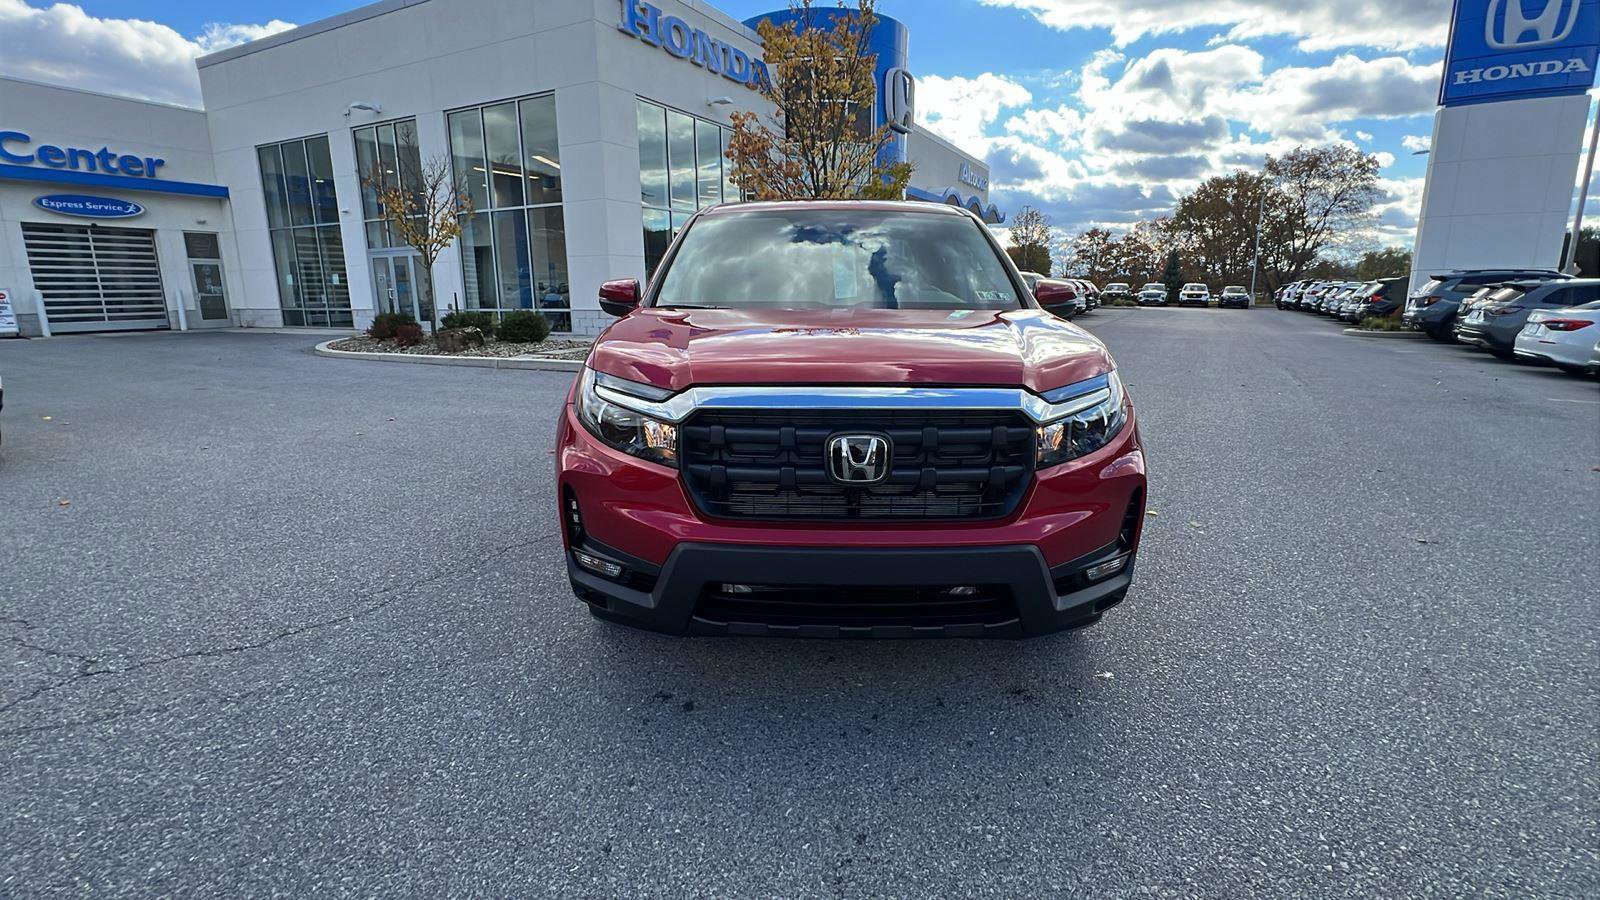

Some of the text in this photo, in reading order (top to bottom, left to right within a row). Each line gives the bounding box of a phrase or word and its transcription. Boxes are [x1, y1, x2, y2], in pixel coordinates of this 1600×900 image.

[616, 0, 773, 94] HONDA
[1453, 58, 1591, 85] HONDA
[0, 130, 165, 178] Center
[42, 199, 123, 211] Express Service
